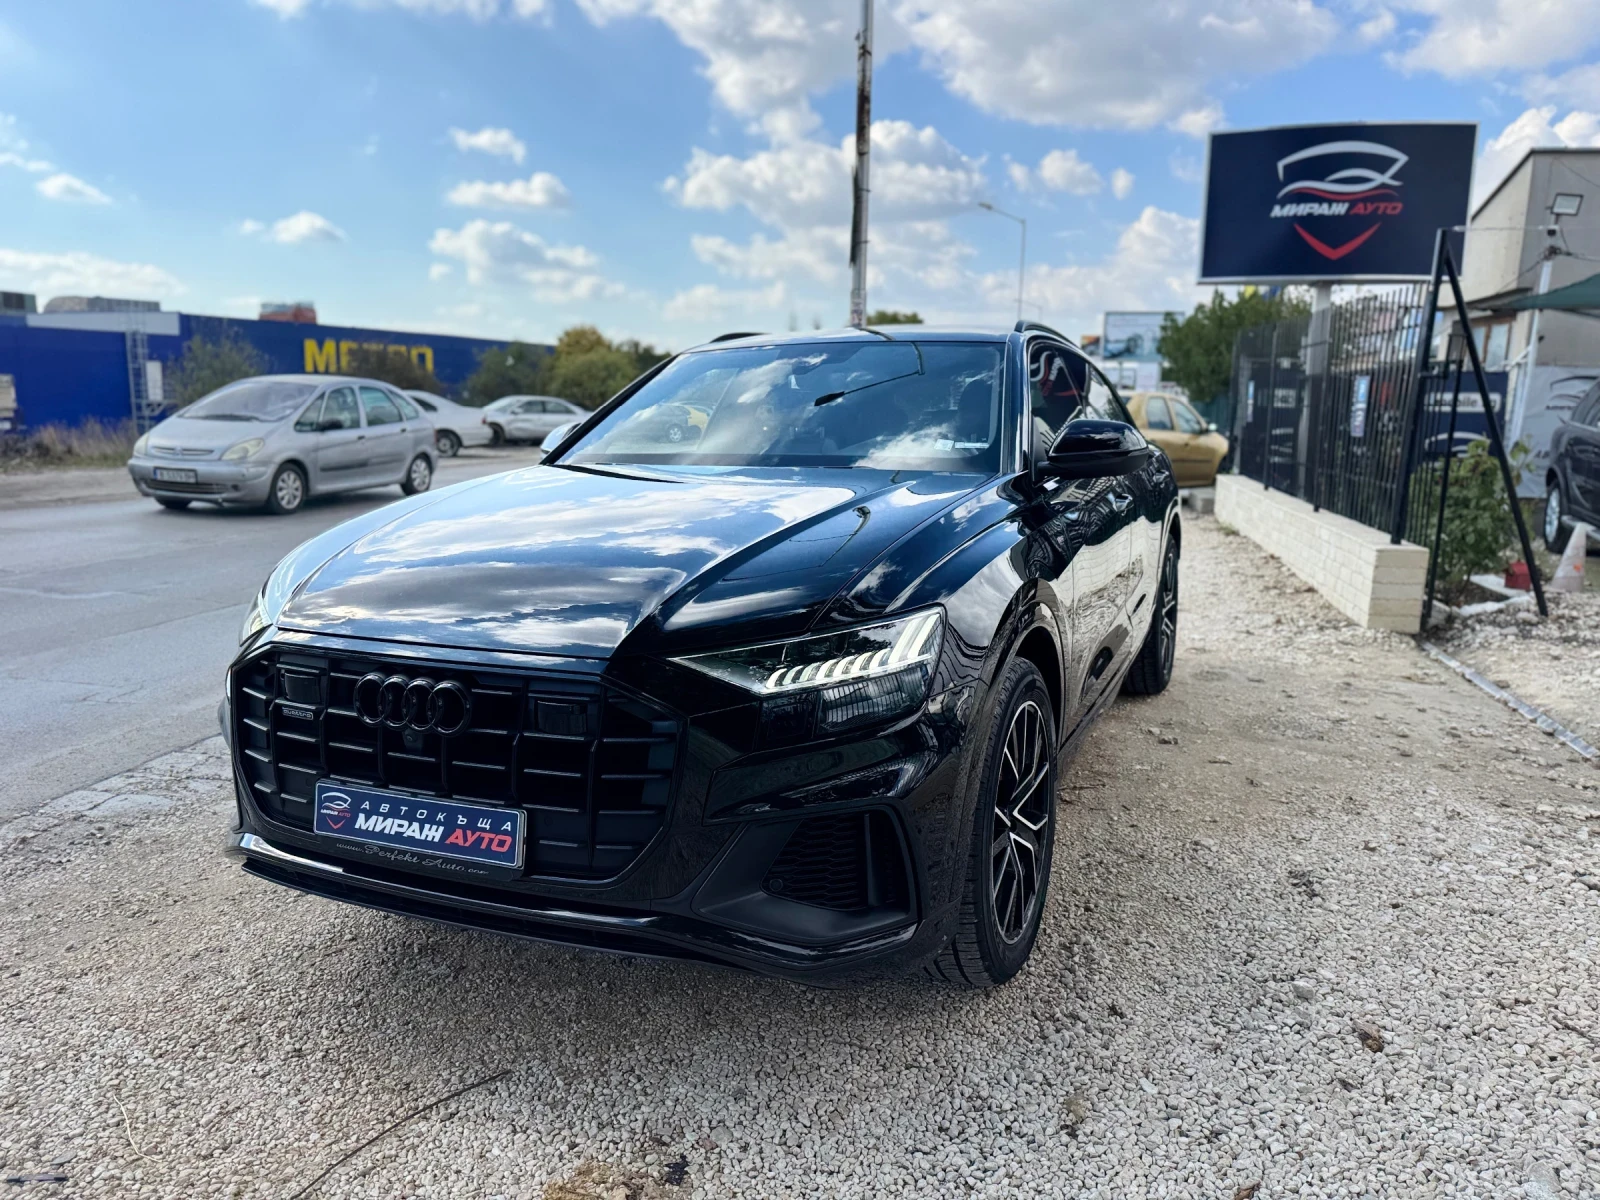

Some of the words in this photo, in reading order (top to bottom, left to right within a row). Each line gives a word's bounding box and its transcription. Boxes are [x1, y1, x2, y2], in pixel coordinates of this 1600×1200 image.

[1270, 202, 1350, 218] МИРАЖ
[1349, 202, 1404, 215] АУТО
[354, 813, 445, 842] МИРАЖ
[444, 828, 513, 853] АУТО
